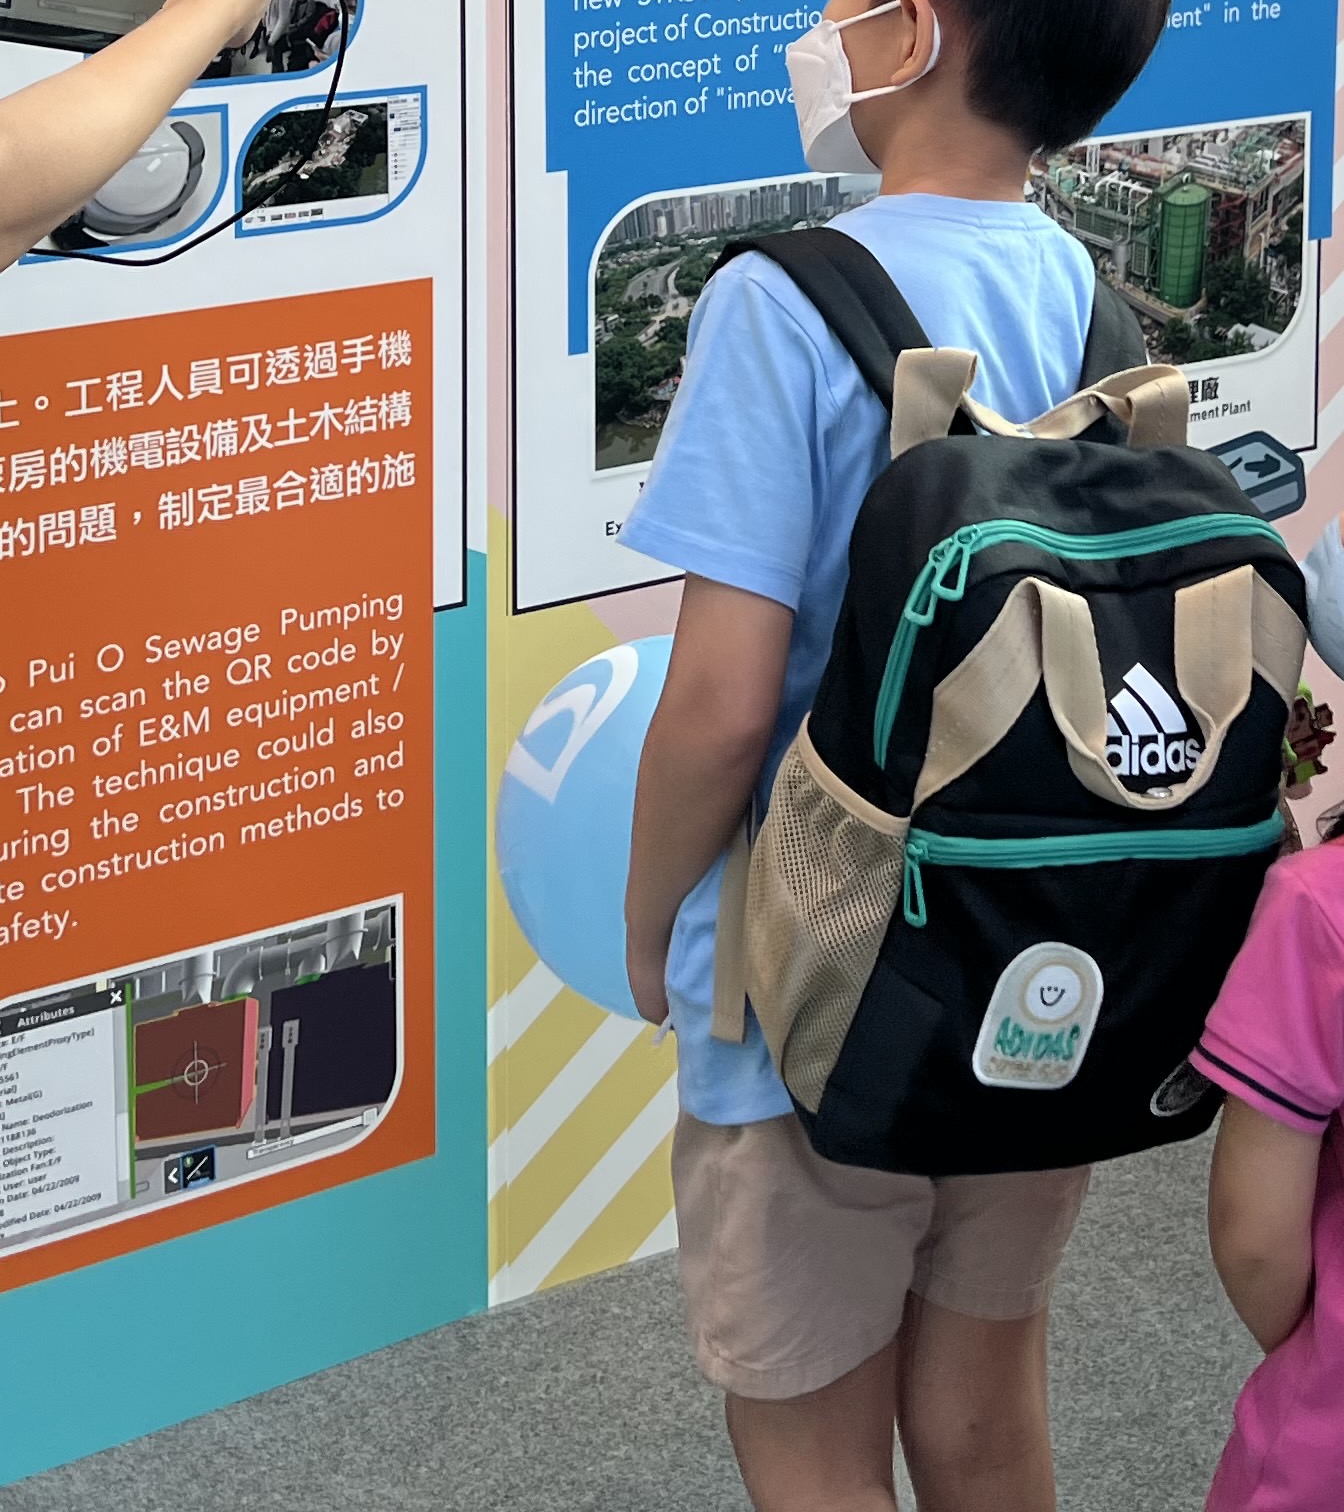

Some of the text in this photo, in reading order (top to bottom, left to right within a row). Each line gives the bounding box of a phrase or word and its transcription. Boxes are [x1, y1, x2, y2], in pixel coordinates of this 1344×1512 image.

[1222, 400, 1251, 417] Plant
[30, 653, 74, 687] Pui
[97, 644, 124, 672] O
[146, 624, 260, 663] Sewage
[281, 593, 402, 635] Pumping
[16, 1005, 76, 1028] Attributes
